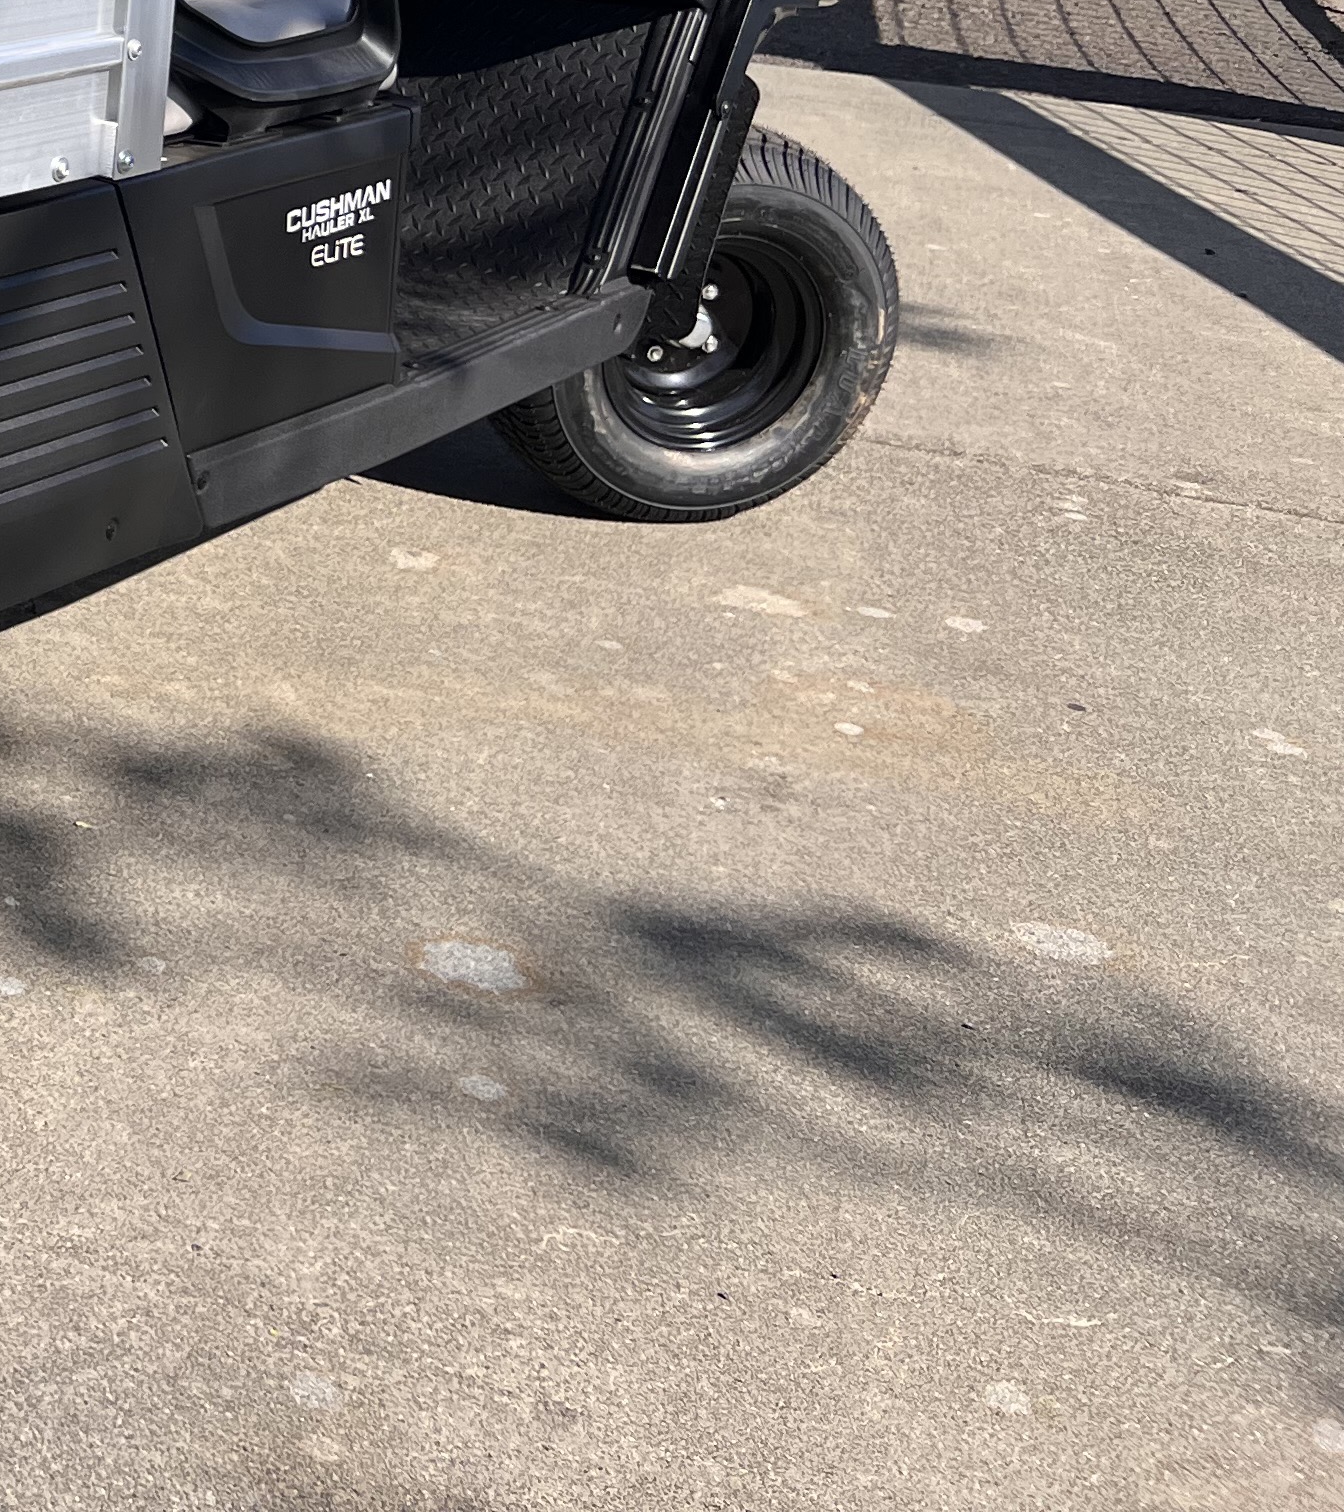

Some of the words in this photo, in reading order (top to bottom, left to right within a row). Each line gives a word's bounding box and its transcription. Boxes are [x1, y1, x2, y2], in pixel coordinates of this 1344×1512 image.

[286, 178, 392, 233] CUSHMAN
[302, 211, 355, 243] HAULER
[358, 206, 375, 225] XL
